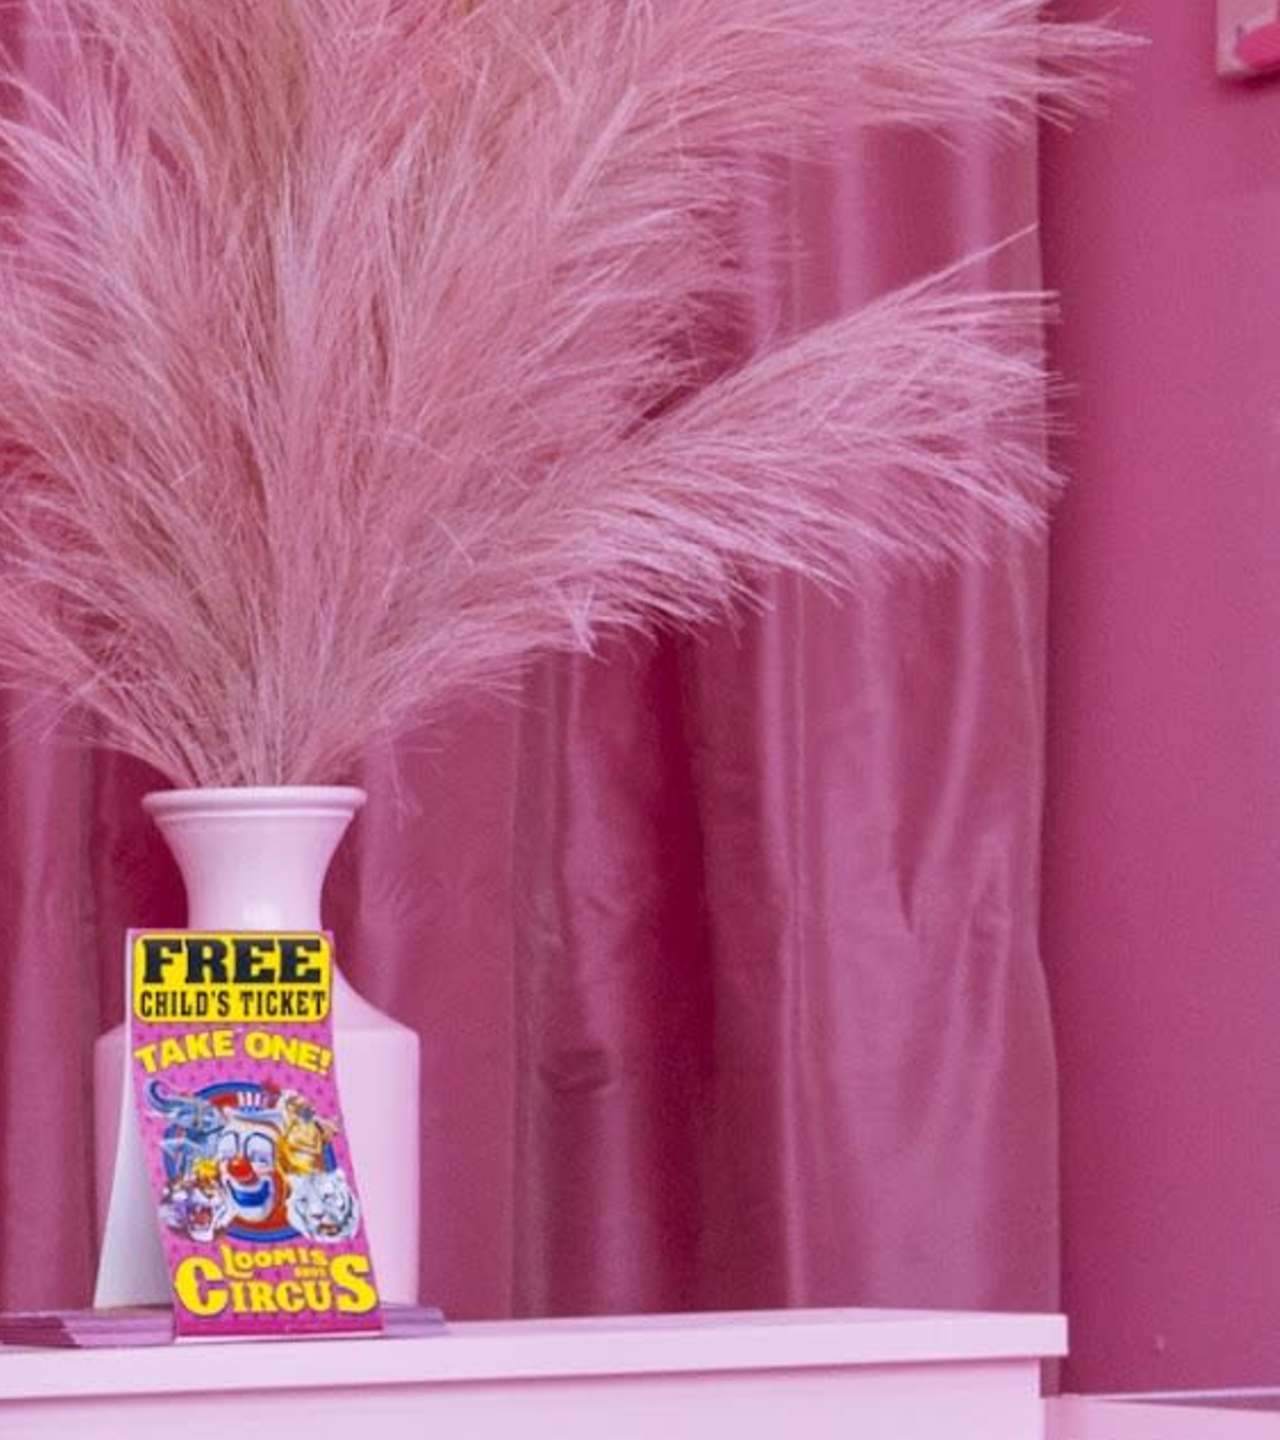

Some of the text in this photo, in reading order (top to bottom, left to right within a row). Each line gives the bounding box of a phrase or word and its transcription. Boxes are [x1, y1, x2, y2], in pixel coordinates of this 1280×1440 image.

[142, 939, 321, 983] FREE
[140, 989, 326, 1017] CHILD'S TICKET
[134, 1029, 334, 1075] TAKE ONE!
[219, 1244, 329, 1279] LOOMIS
[174, 1254, 379, 1316] CIRCUS
